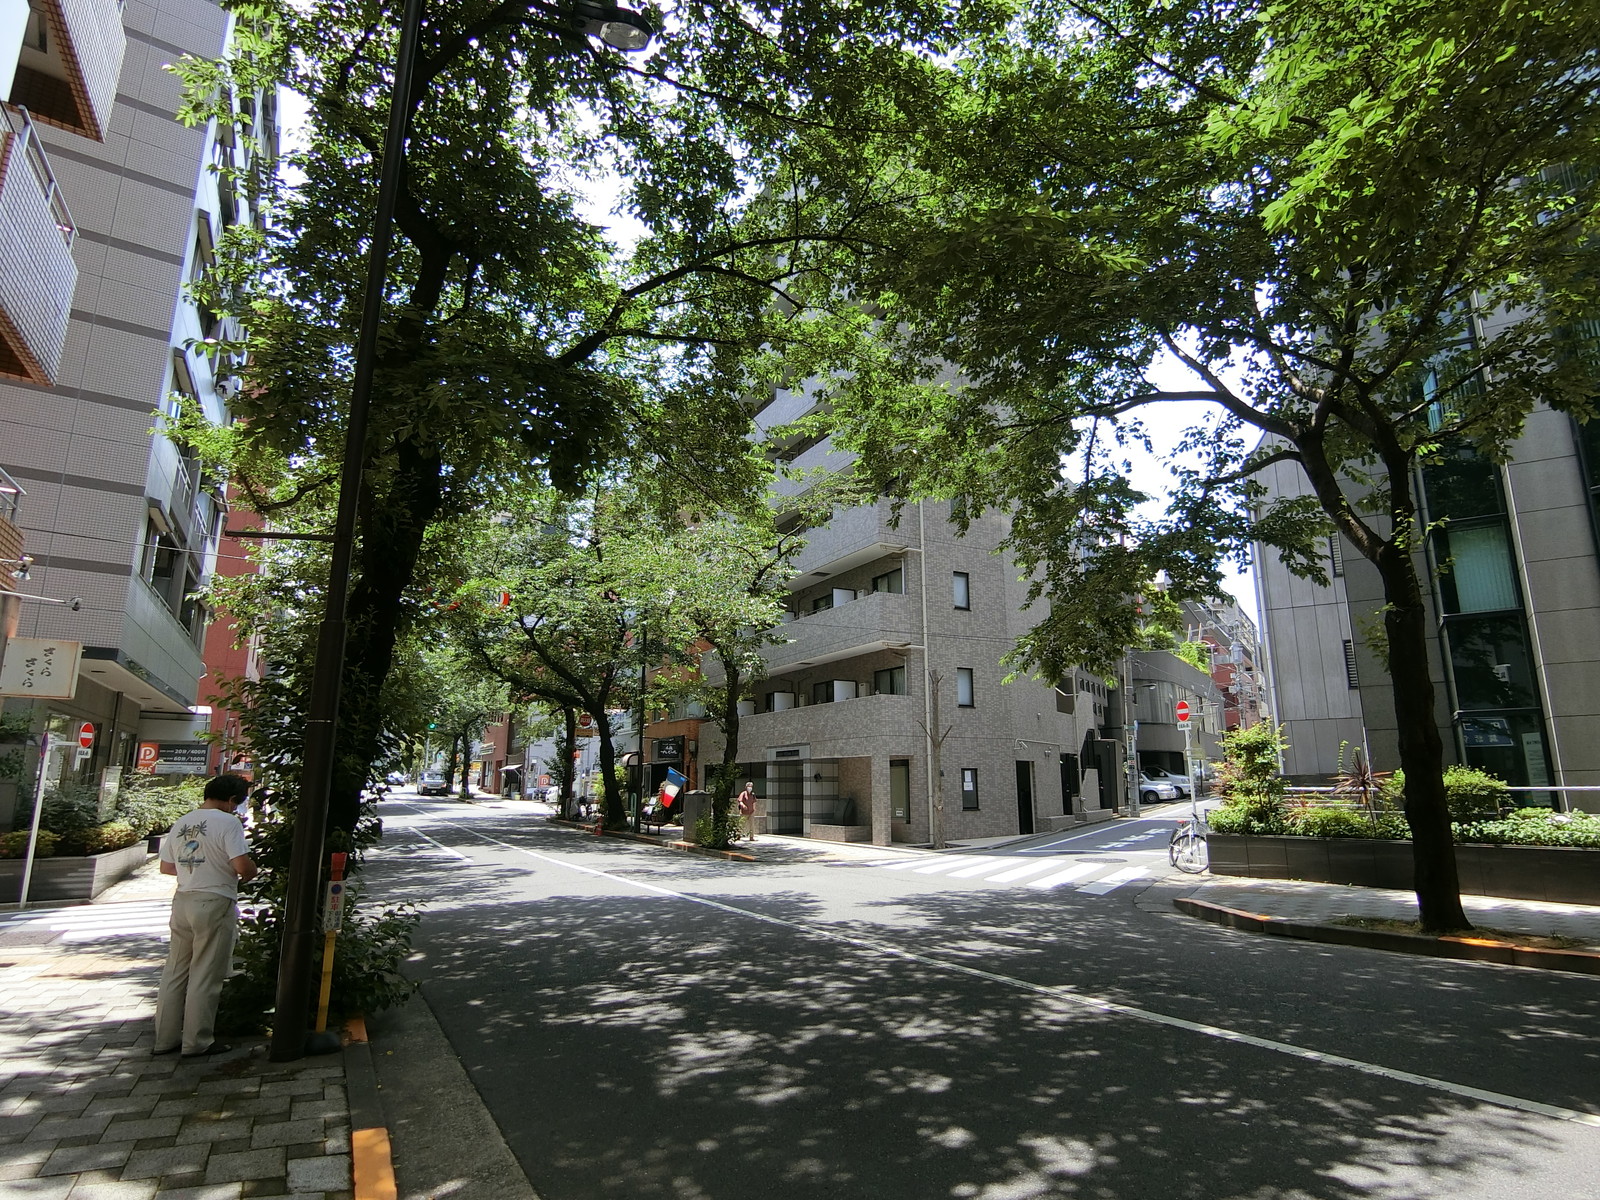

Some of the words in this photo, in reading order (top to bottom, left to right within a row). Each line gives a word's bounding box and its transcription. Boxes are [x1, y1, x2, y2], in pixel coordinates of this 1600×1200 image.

[22, 657, 39, 688] さくら
[40, 646, 57, 678] さくら
